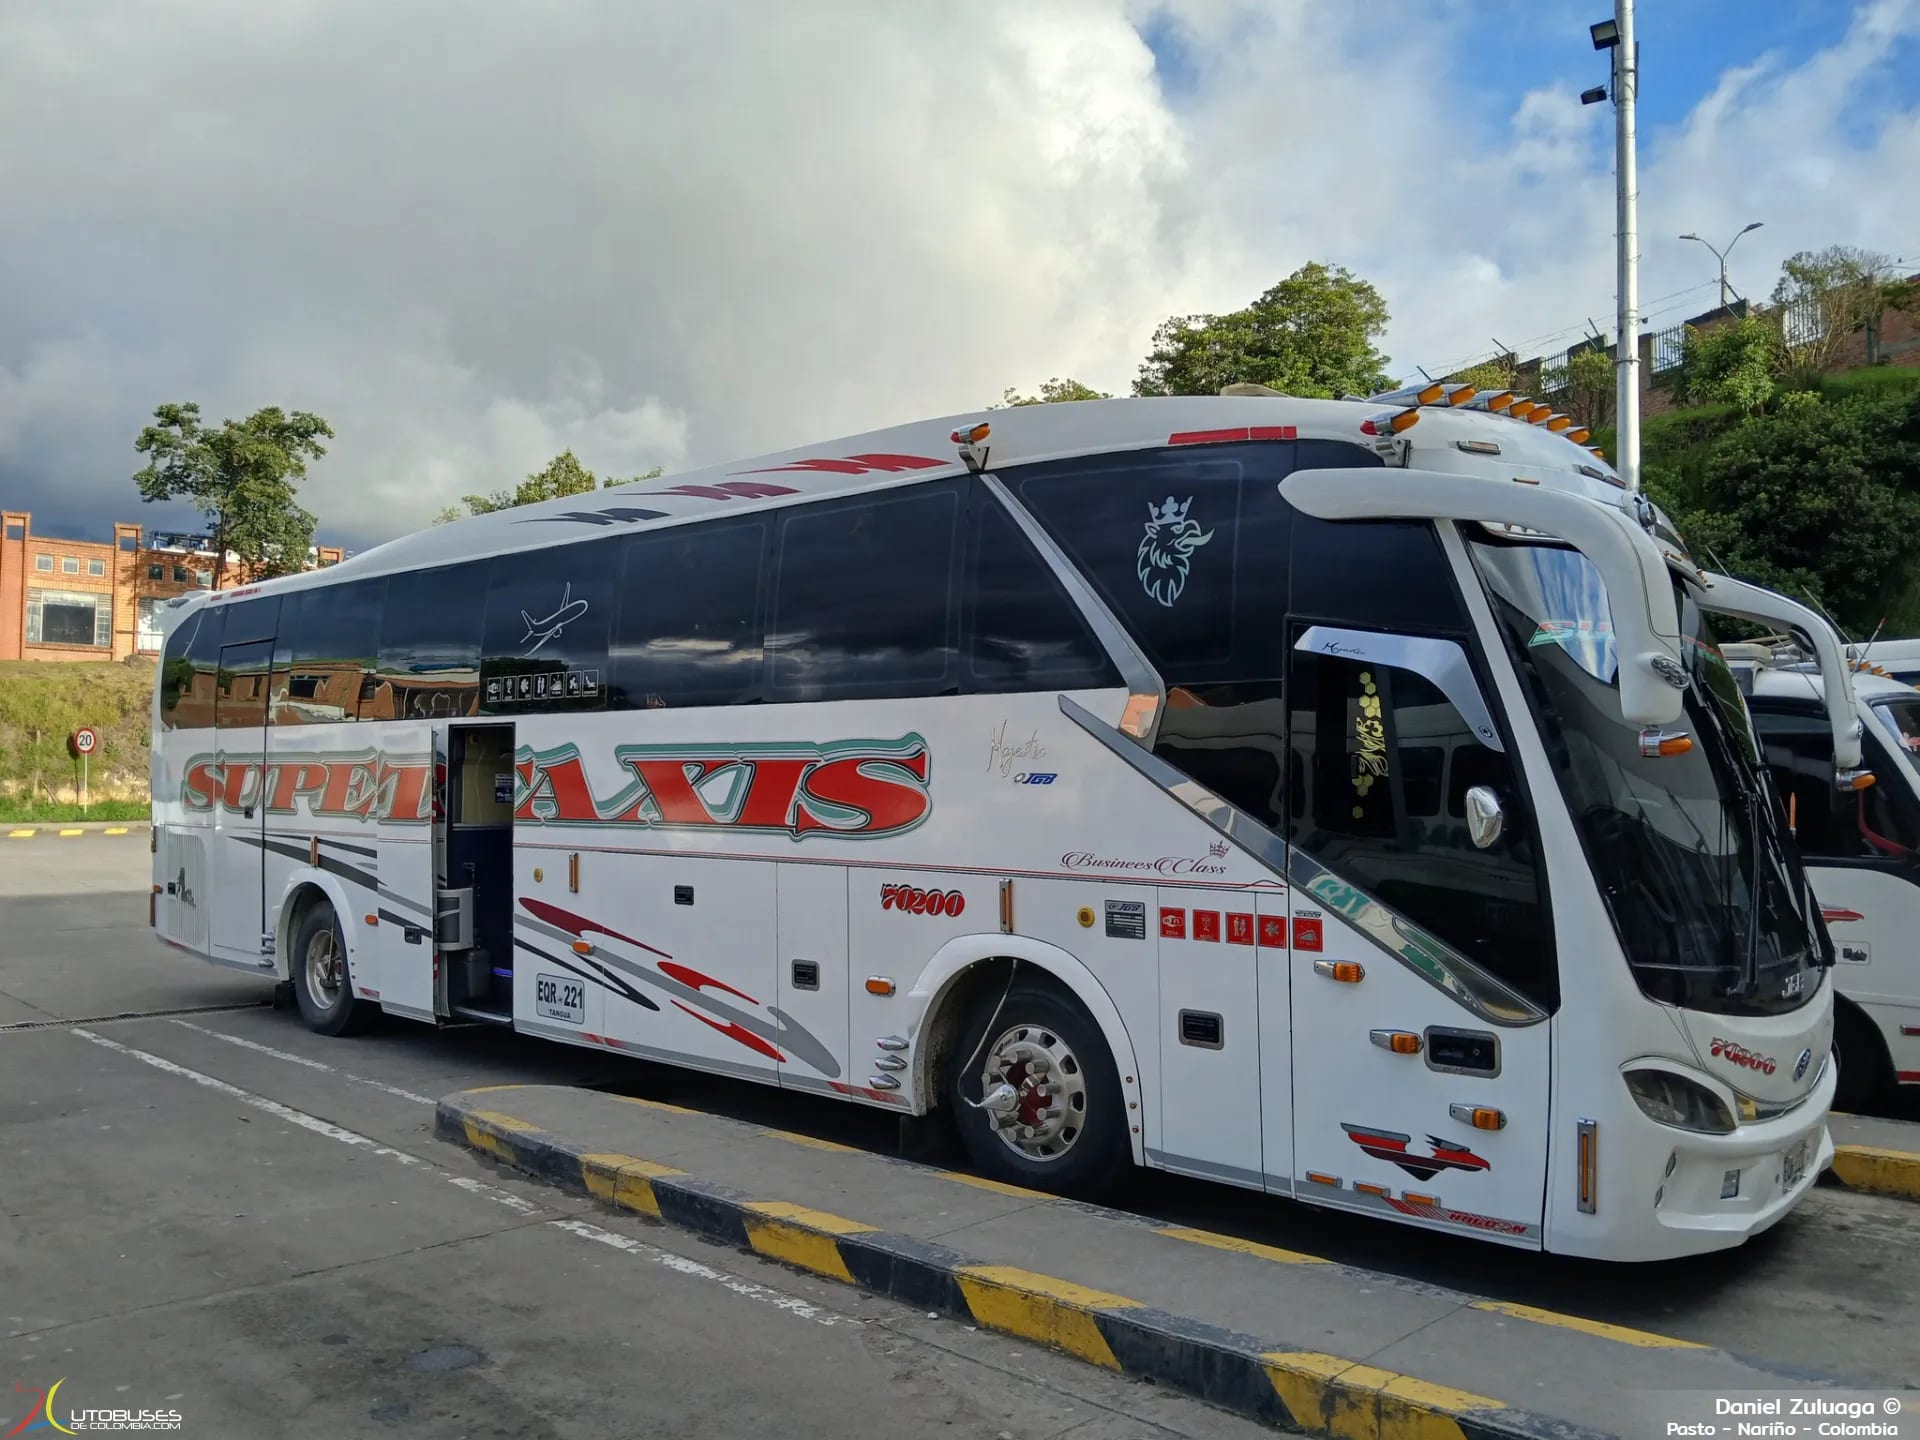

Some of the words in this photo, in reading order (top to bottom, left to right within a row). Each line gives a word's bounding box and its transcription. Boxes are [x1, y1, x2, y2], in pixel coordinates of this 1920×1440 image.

[79, 734, 92, 746] 20
[1021, 773, 1058, 785] JGB
[1153, 853, 1227, 877] Class
[880, 883, 966, 918] 70200
[1710, 1036, 1777, 1075] 70200
